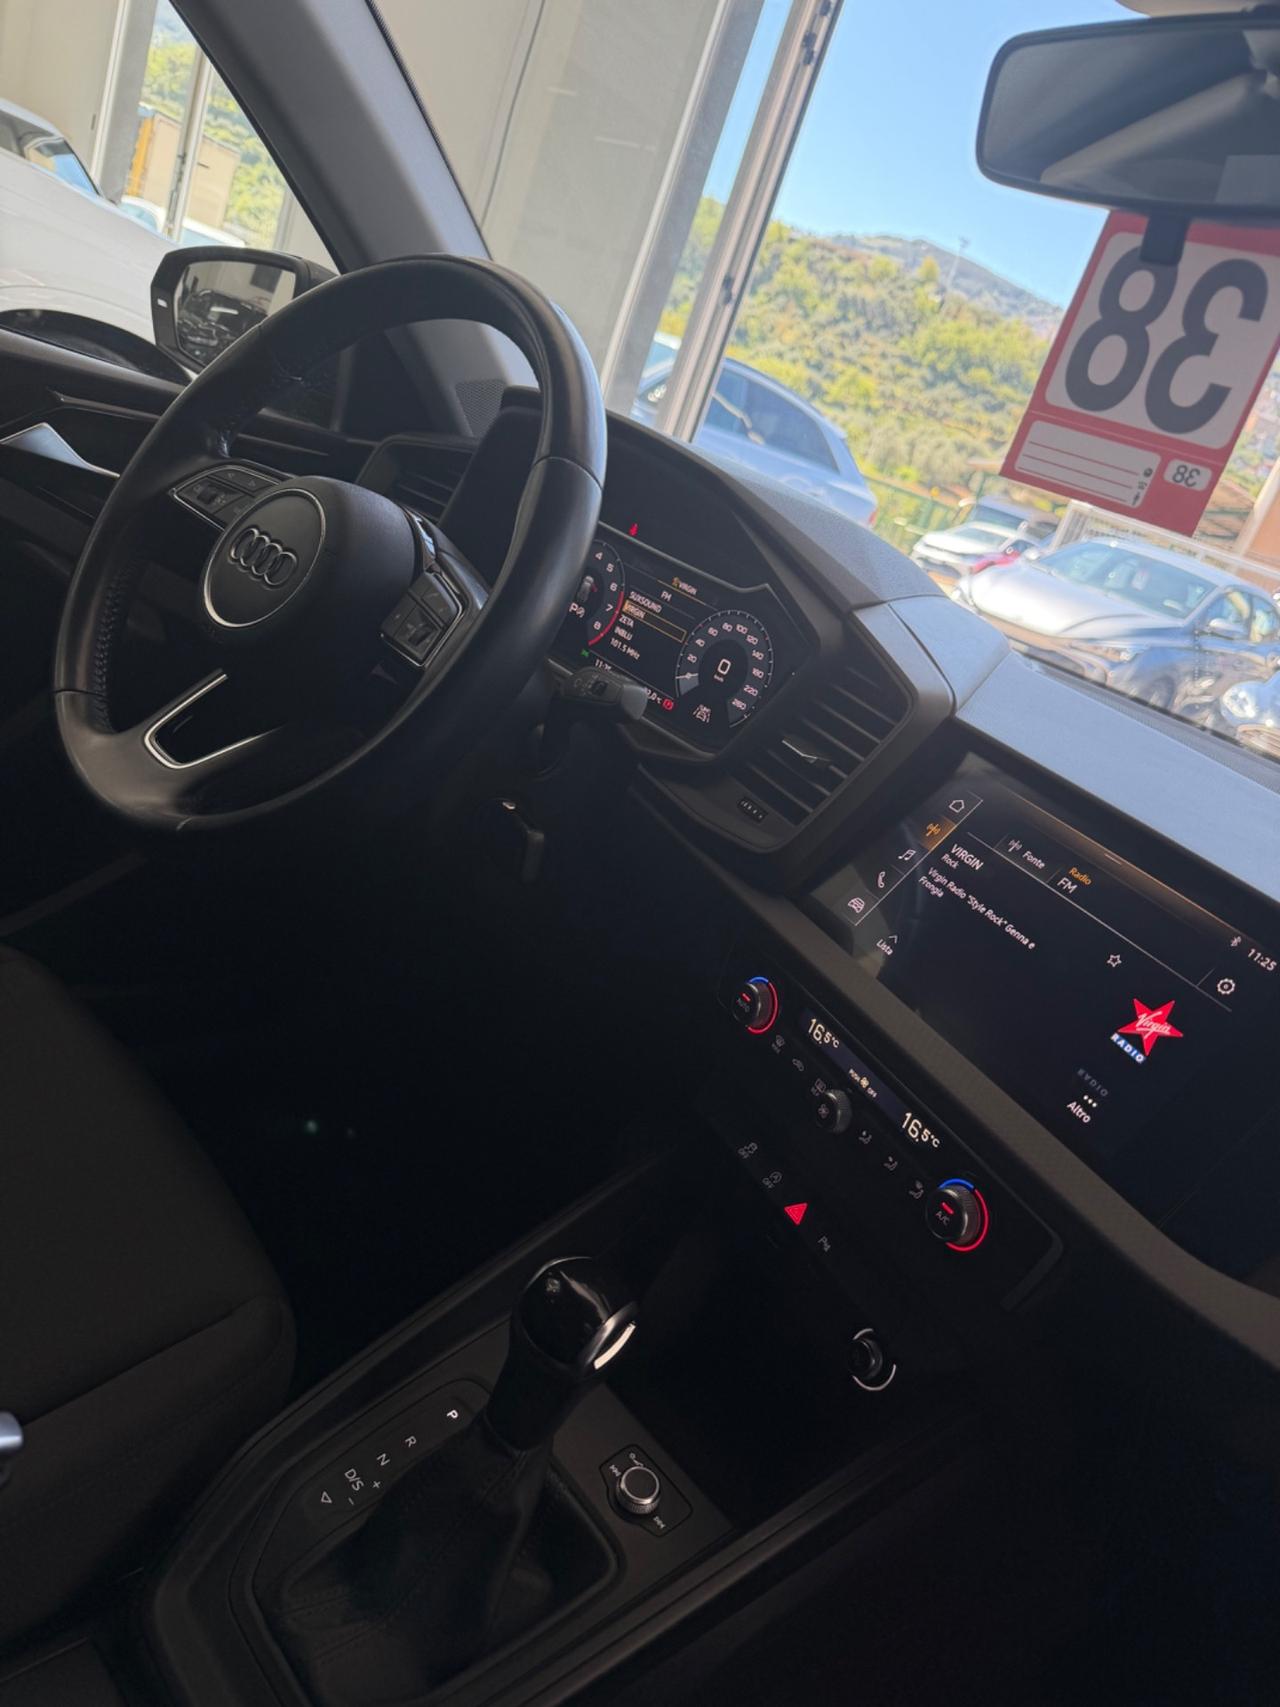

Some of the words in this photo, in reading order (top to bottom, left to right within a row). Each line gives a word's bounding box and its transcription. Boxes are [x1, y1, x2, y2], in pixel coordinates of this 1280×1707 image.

[595, 552, 603, 560] 4
[606, 563, 614, 572] 5
[609, 582, 618, 591] 6
[661, 590, 672, 601] FM
[605, 603, 613, 612] 7
[593, 621, 601, 630] 8
[619, 614, 635, 628] ZETA
[626, 647, 640, 660] MHz
[687, 653, 697, 663] 20
[717, 658, 731, 675] 0
[743, 685, 758, 697] 220
[941, 853, 959, 869] Rock
[951, 843, 984, 870] VIRGIN
[1022, 850, 1045, 869] Fonte
[1069, 867, 1091, 885] Radio
[1057, 877, 1078, 894] FM
[928, 867, 949, 887] Virgin
[946, 881, 967, 899] Radio
[1028, 942, 1036, 950] e
[876, 938, 893, 956] Lista
[1247, 948, 1277, 971] 11:25
[1136, 1011, 1171, 1039] Virgin
[1110, 1033, 1145, 1064] RADIO
[1066, 1101, 1091, 1123] Altro
[446, 1409, 459, 1419] P
[405, 1435, 417, 1448] R
[376, 1453, 391, 1466] N
[344, 1468, 364, 1491] D/S
